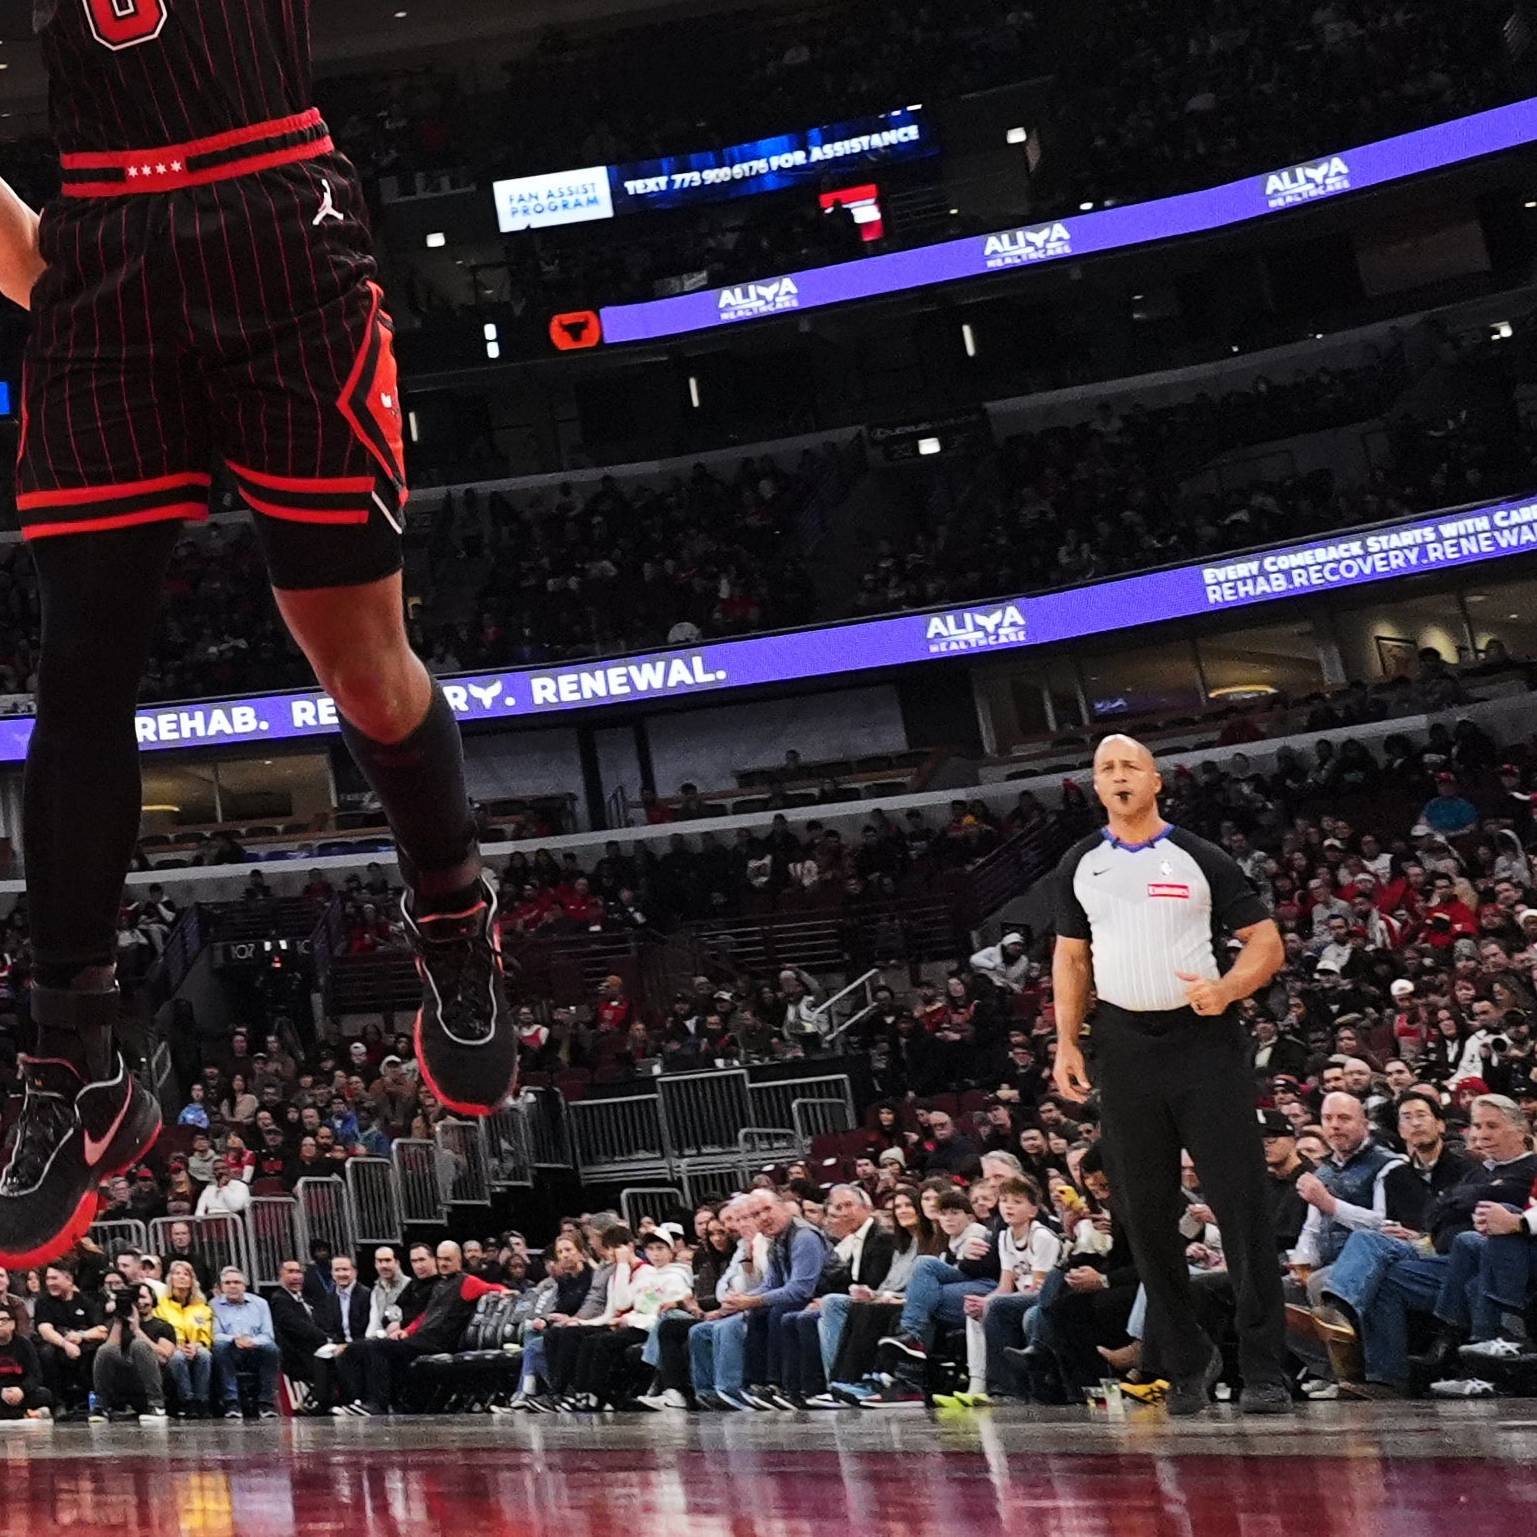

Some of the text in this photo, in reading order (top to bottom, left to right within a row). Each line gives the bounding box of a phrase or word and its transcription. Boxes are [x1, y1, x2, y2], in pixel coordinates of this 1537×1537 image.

[624, 177, 670, 196] TEXT
[769, 152, 807, 172] FOR
[809, 124, 921, 163] ASSISTANCE
[507, 182, 599, 205] FAN ASSIST
[510, 195, 601, 218] PROGRAM
[1438, 515, 1491, 544] WITH
[134, 710, 269, 744] REHAB.
[532, 656, 727, 705] RENEWAL.
